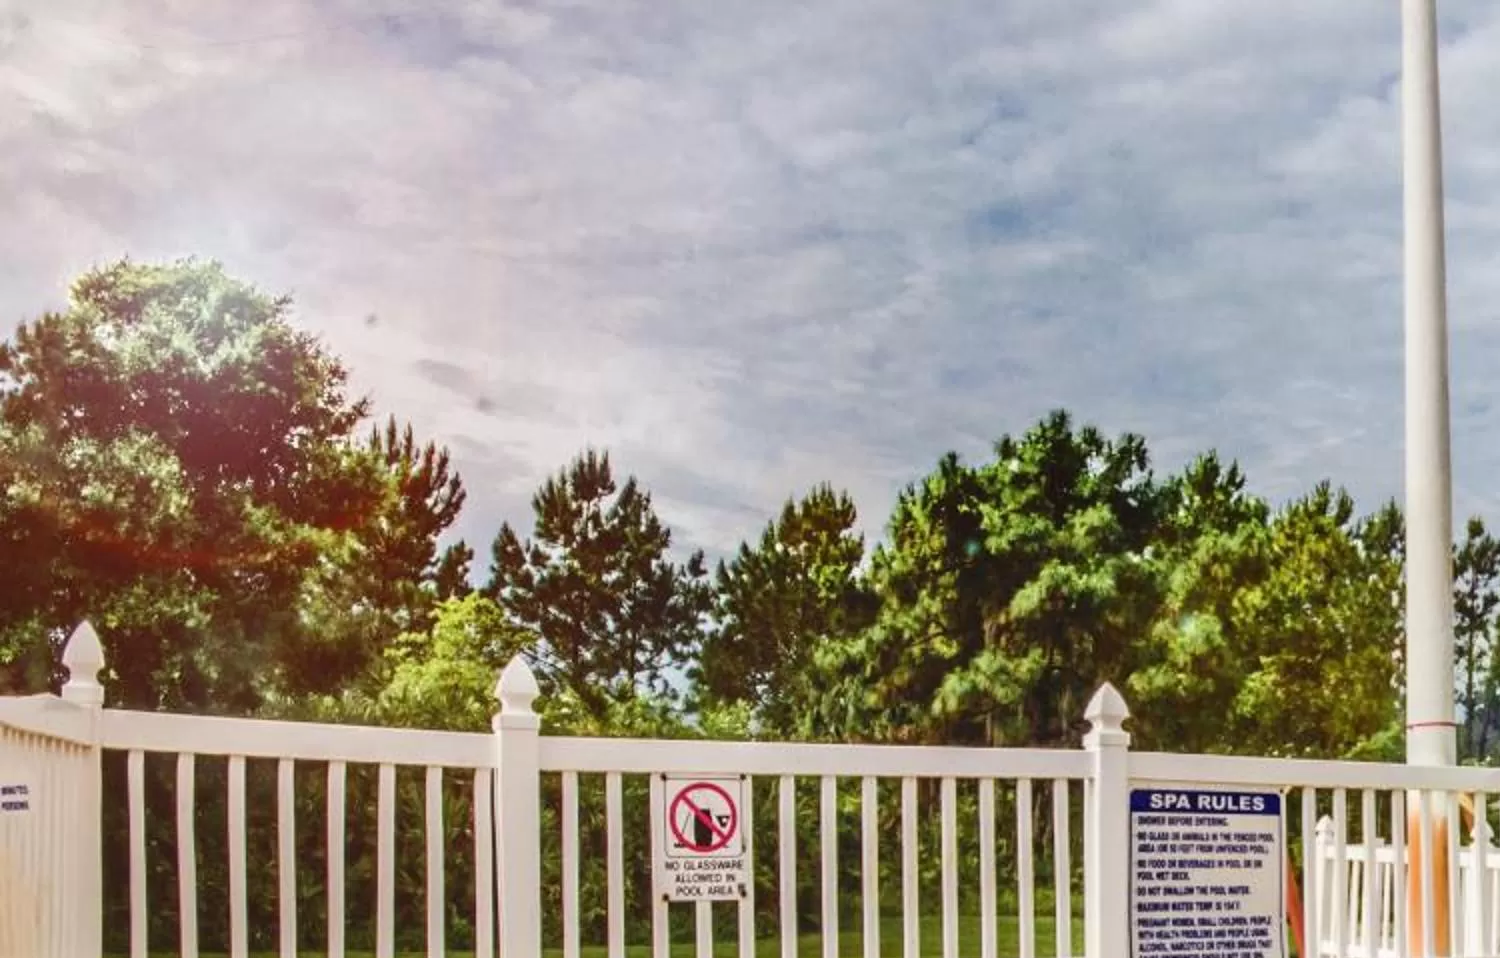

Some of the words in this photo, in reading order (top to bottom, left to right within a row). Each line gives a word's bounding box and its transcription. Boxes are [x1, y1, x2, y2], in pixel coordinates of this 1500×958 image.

[1150, 794, 1190, 808] SPA
[1198, 795, 1265, 811] RULES
[665, 861, 679, 870] NO
[684, 860, 744, 870] GLASSWARE
[675, 874, 721, 883] ALLOWED
[726, 874, 736, 882] IN
[676, 885, 704, 896] POOL
[708, 886, 733, 895] AREA
